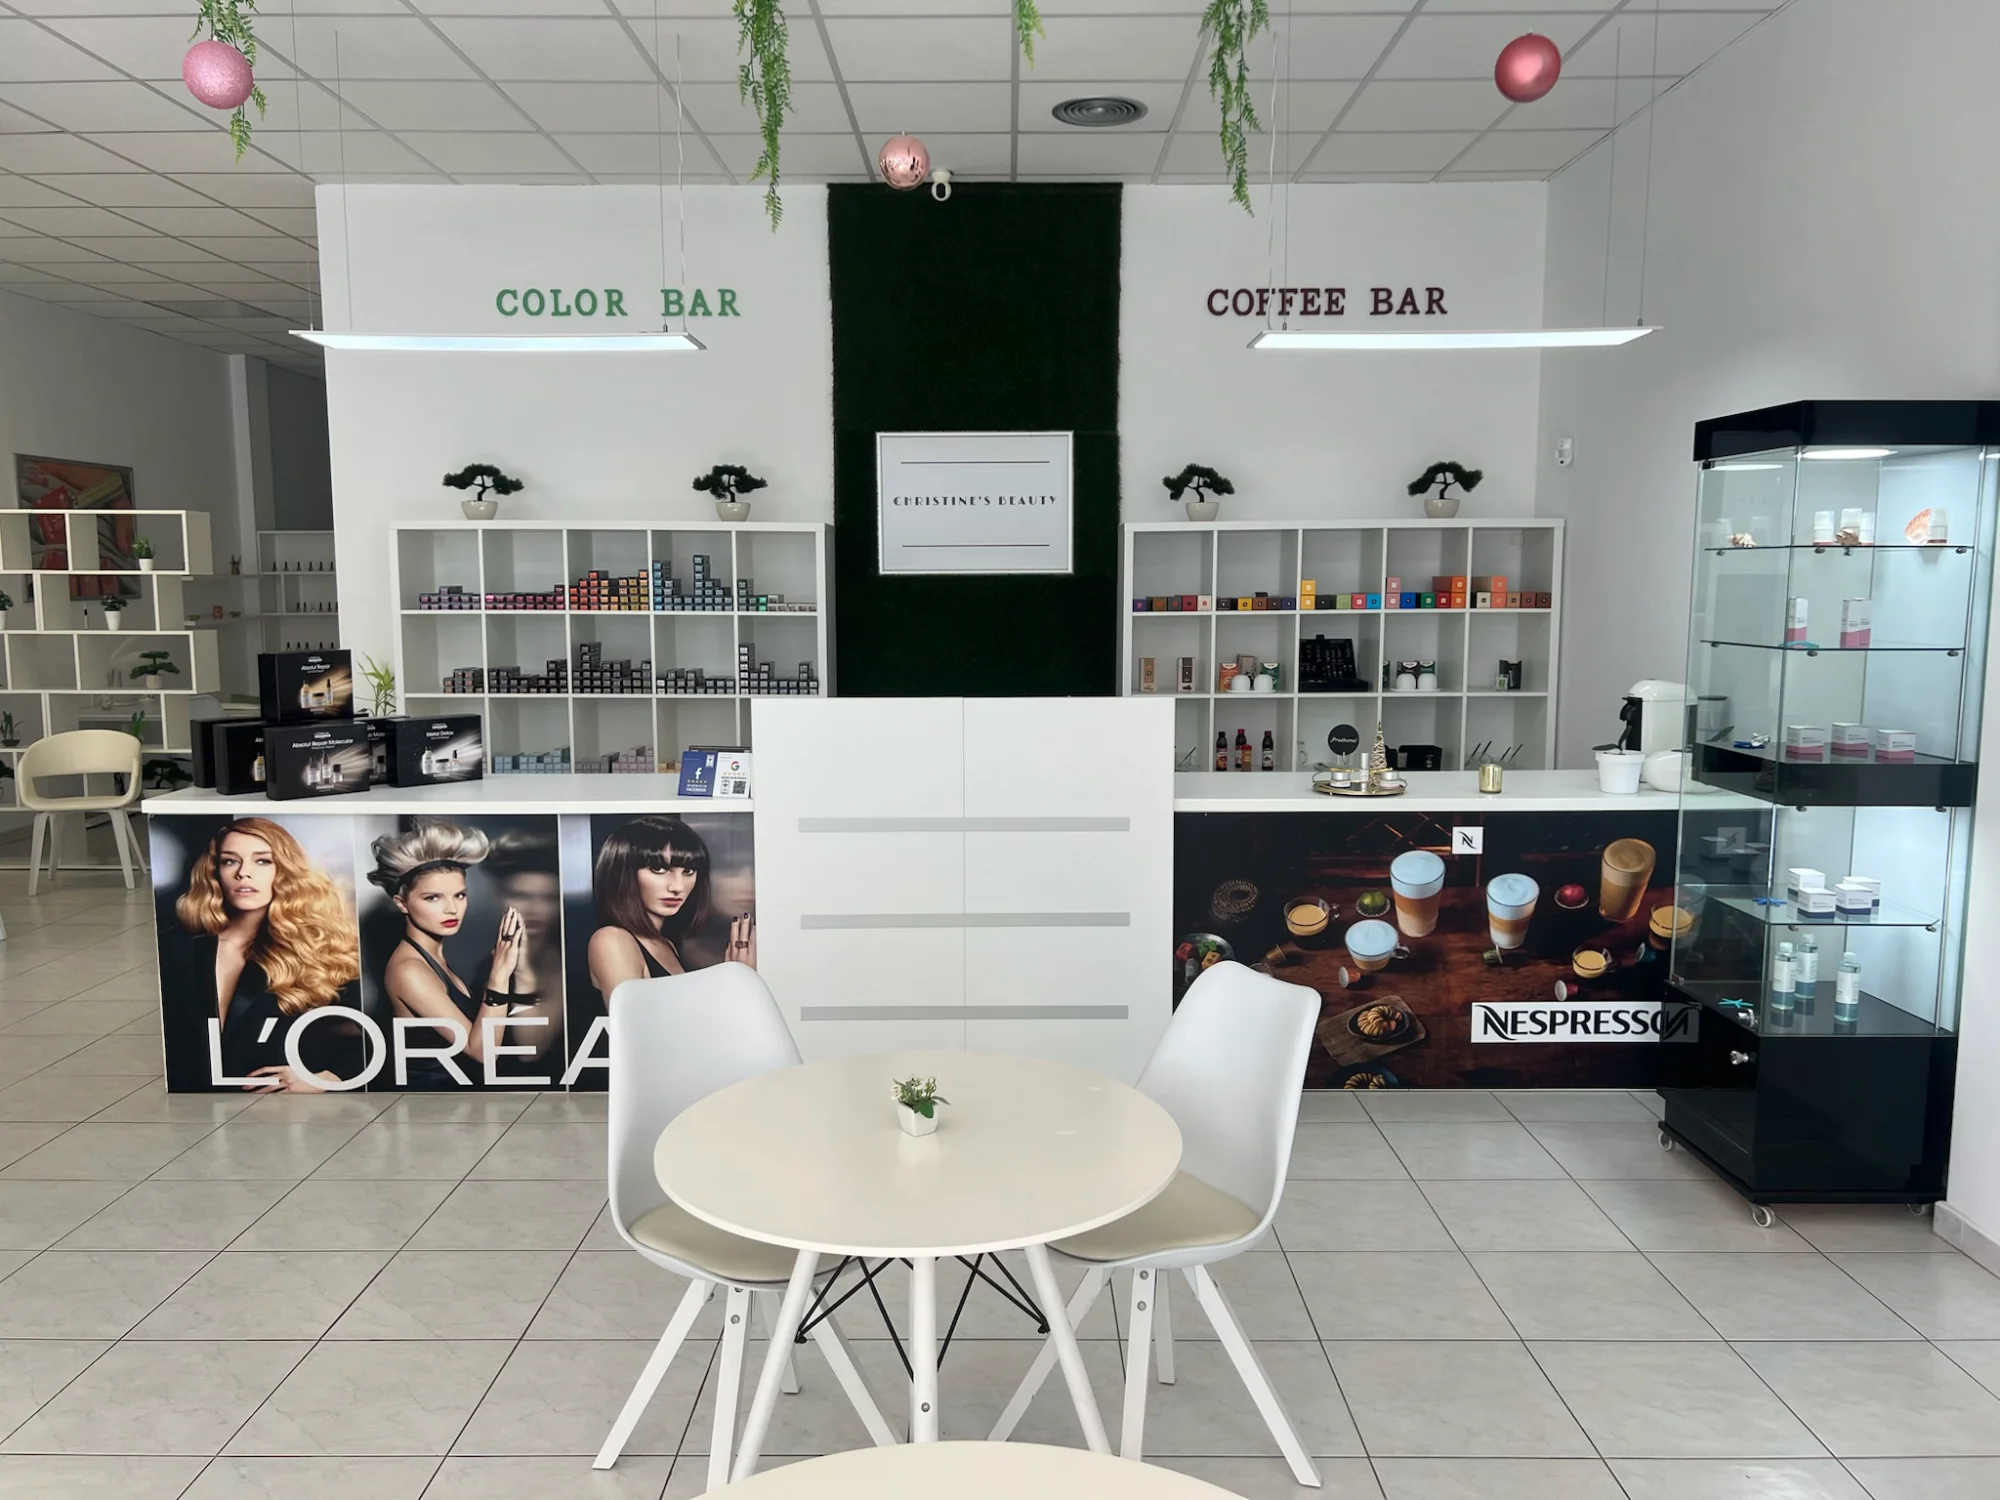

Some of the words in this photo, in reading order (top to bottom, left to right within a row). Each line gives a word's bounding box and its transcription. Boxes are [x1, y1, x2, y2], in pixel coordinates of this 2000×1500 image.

[495, 288, 628, 317] COLOR
[660, 288, 741, 317] BAR
[1207, 287, 1346, 317] COFFEE
[1369, 287, 1448, 316] BAR
[893, 496, 991, 506] CHRISTINE'S
[998, 495, 1058, 506] BEAUTY
[207, 1004, 609, 1091] L'ORÉA
